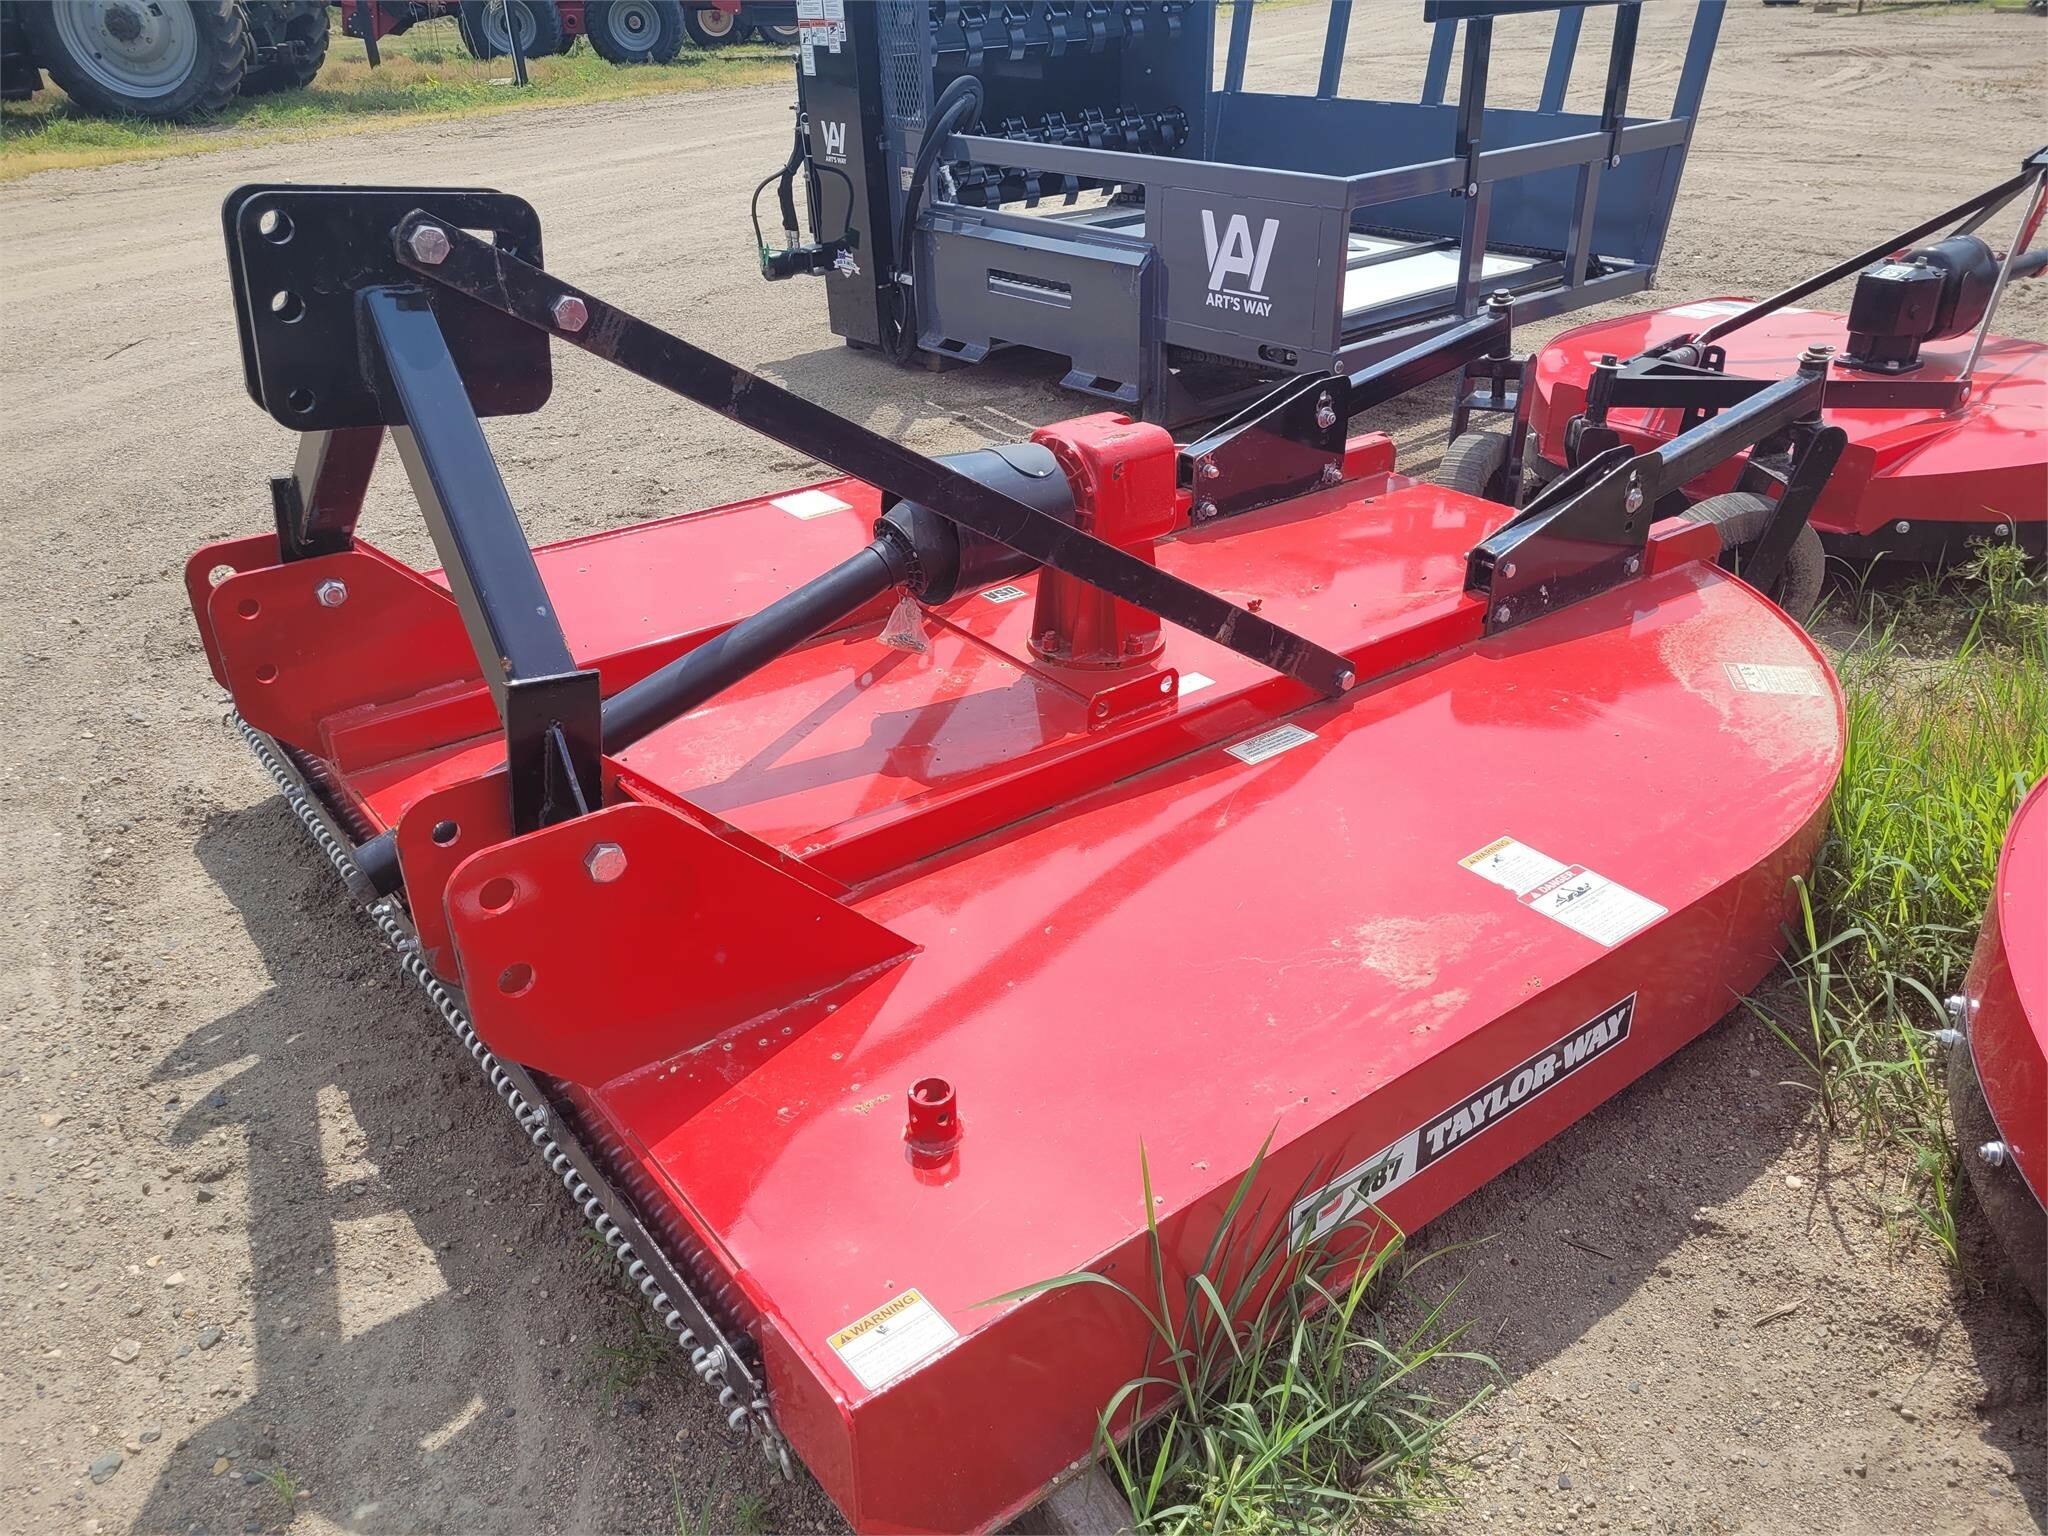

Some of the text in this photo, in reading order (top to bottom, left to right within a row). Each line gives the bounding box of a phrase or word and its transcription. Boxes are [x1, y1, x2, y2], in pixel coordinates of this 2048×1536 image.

[1206, 293, 1272, 317] ART'S WAY
[984, 586, 1019, 600] USA
[1475, 839, 1510, 862] WARNING
[1538, 871, 1577, 893] DANGER
[1426, 1007, 1626, 1155] TAYLOR-WAY
[849, 1295, 915, 1336] WARNING
